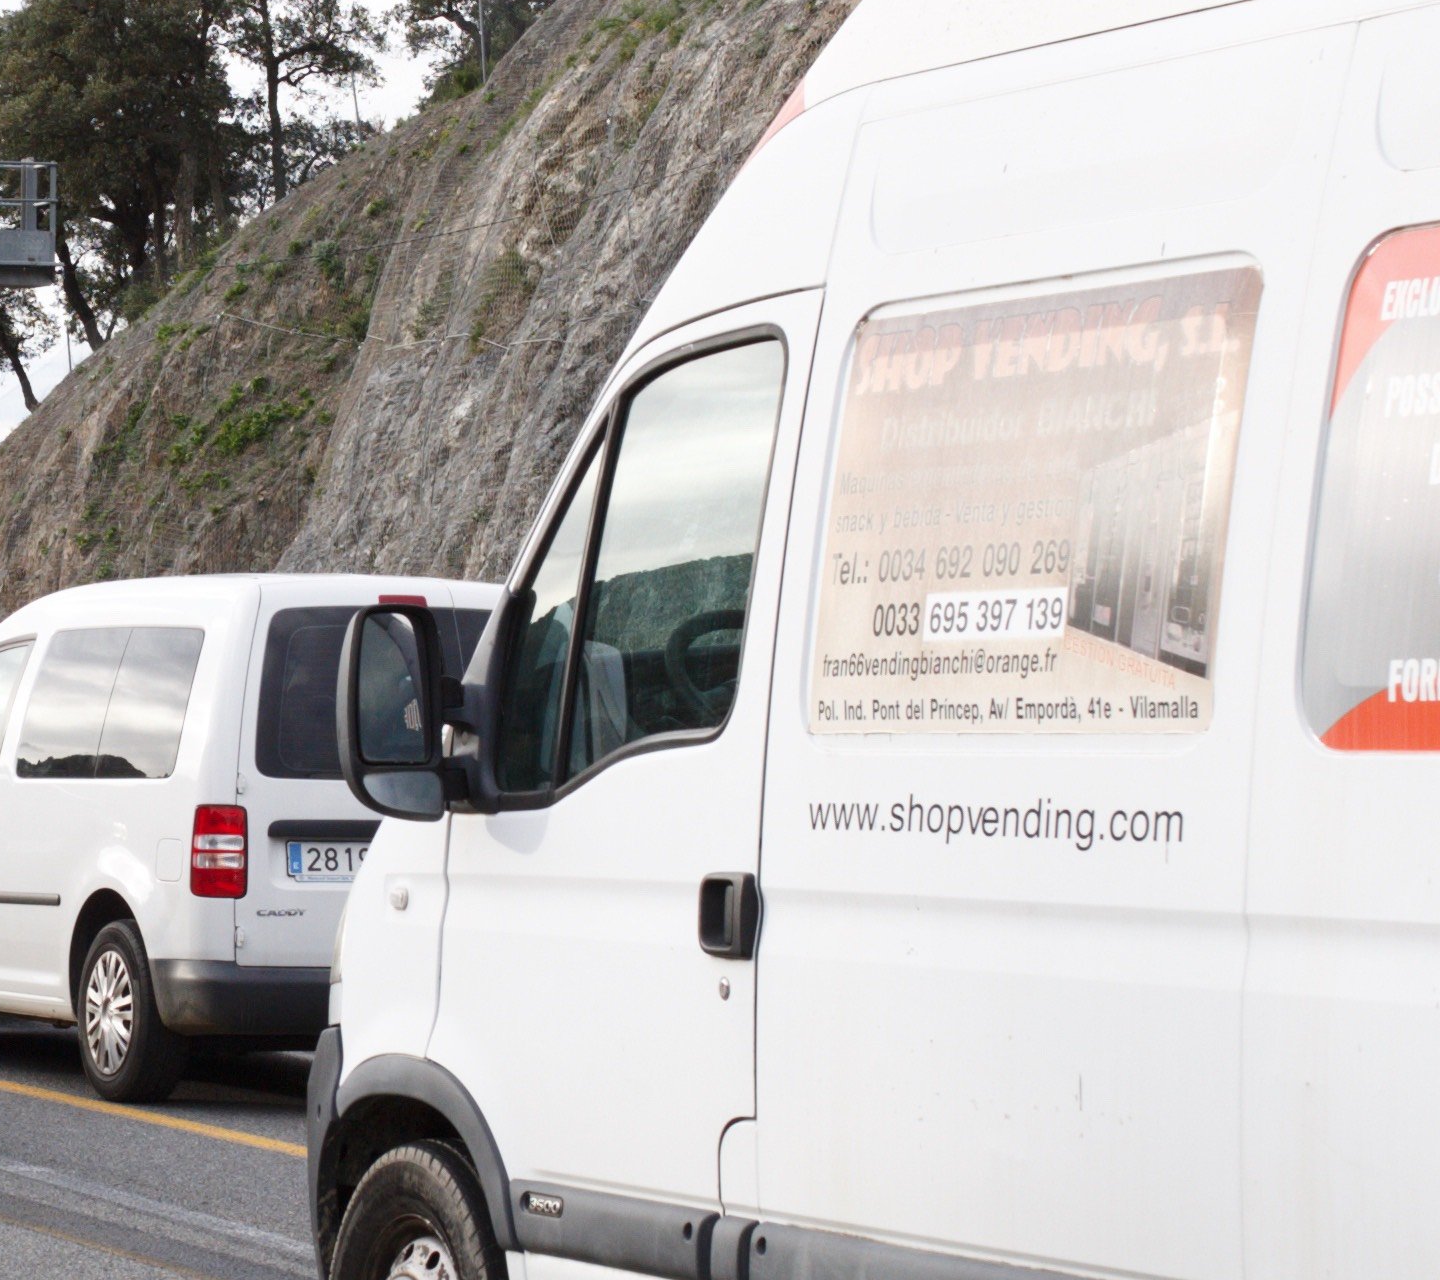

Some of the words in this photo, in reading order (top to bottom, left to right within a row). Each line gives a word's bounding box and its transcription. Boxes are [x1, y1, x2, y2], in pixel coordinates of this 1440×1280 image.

[855, 322, 964, 397] SHOP
[972, 294, 1170, 381] VENDING,
[1035, 387, 1161, 437] BIANCHI
[834, 508, 875, 535] snack
[878, 512, 889, 536] y
[955, 499, 995, 525] Venta
[1000, 502, 1012, 527] y
[831, 552, 870, 586] Tel.:
[878, 547, 926, 583] 0034
[934, 544, 974, 580] 692
[982, 541, 1021, 577] 090
[1030, 539, 1071, 575] 269
[873, 602, 922, 637] 0033
[930, 601, 970, 634] 695
[976, 598, 1018, 632] 397
[1026, 596, 1064, 630] 139
[822, 647, 1058, 682] fran66vendingbianchi@orange.fr
[818, 699, 839, 721] Pol.
[843, 699, 867, 721] Ind.
[872, 698, 900, 721] Pont
[905, 698, 925, 721] del
[988, 696, 1010, 721] Av/
[1015, 696, 1082, 725] Empordà,
[1087, 696, 1112, 720] 41e
[1129, 695, 1199, 721] Vilamalla
[808, 793, 1185, 852] www.shopvending.com
[256, 908, 307, 917] CADDY
[529, 1197, 560, 1214] 3500
